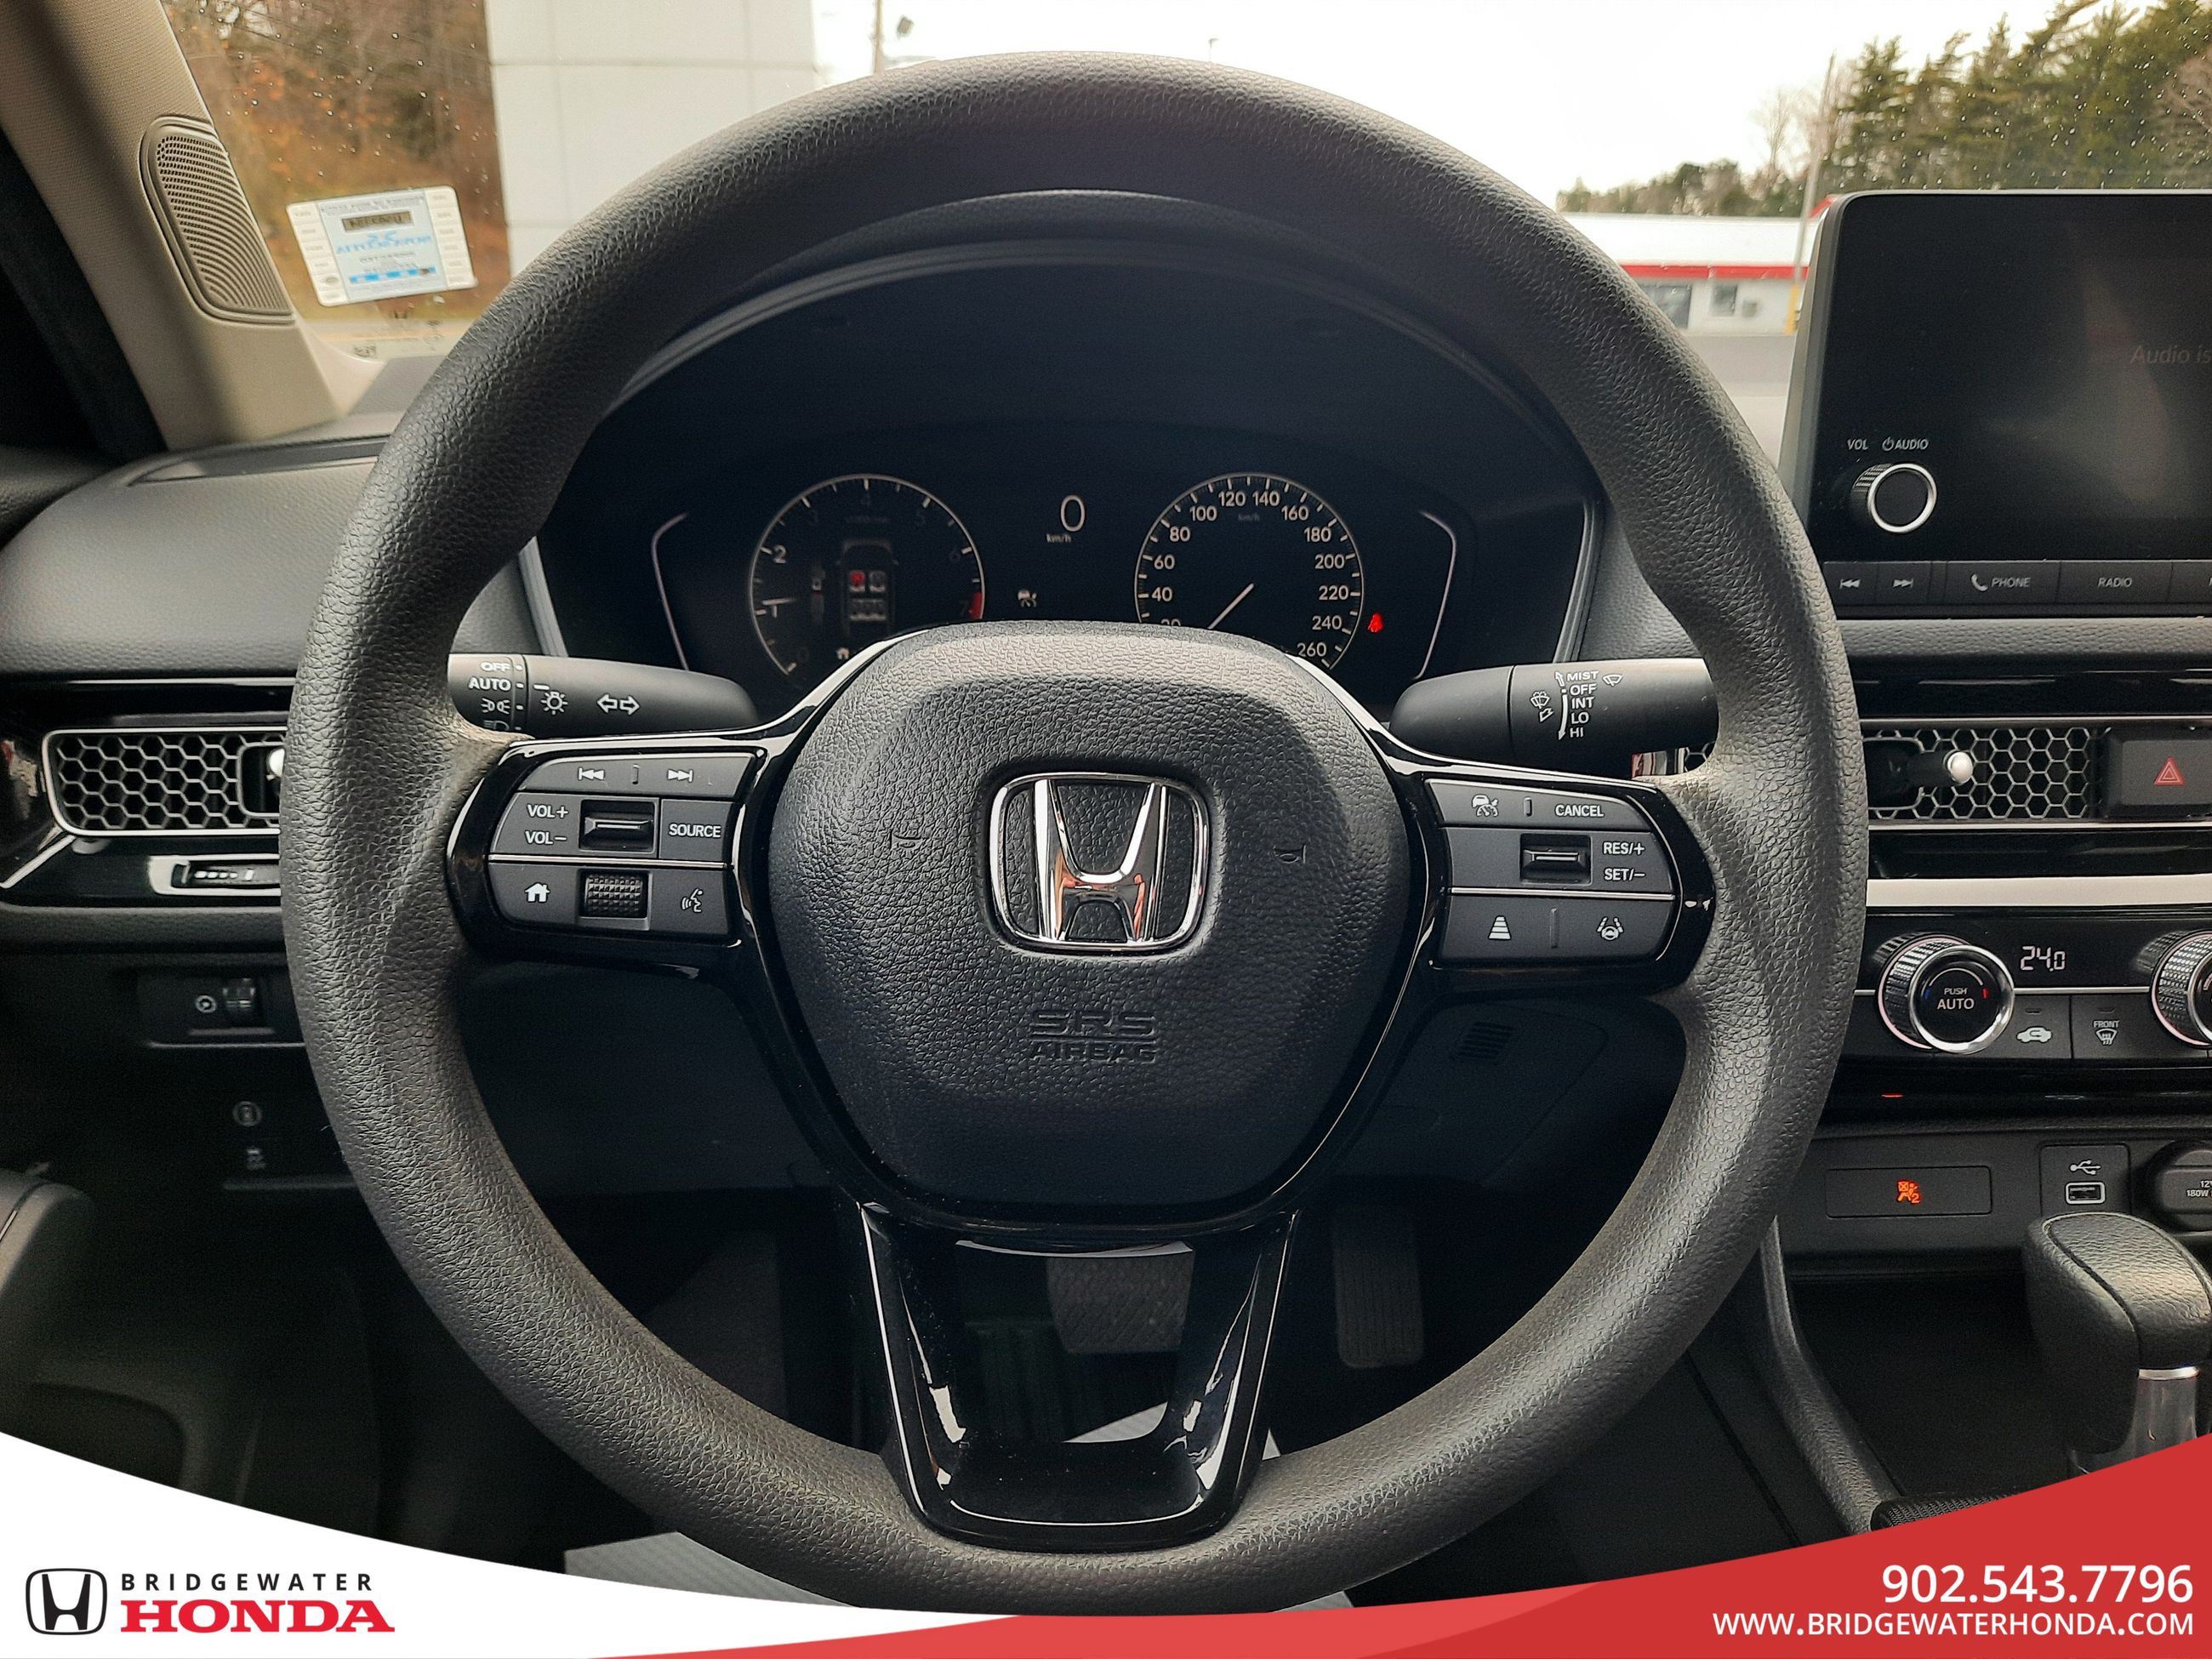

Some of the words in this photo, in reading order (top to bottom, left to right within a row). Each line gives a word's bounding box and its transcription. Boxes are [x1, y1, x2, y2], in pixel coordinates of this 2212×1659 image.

[2129, 345, 2190, 364] Audio
[1847, 438, 1869, 450] VOL
[1895, 438, 1929, 450] AUDIO
[1218, 491, 1246, 507] 120
[1252, 491, 1280, 507] 140
[1060, 494, 1086, 532] 0
[1190, 505, 1217, 522] 100
[1238, 513, 1260, 523] km/h
[1281, 505, 1308, 522] 160
[1046, 533, 1072, 544] km/h
[1169, 527, 1190, 543] 80
[1303, 527, 1332, 543] 180
[774, 544, 786, 563] 2
[1154, 555, 1176, 570] 60
[1314, 554, 1345, 569] 200
[1991, 577, 2031, 589] PHONE
[2097, 577, 2132, 589] RADIO
[1151, 587, 1172, 602] 40
[1319, 585, 1349, 601] 220
[1312, 615, 1342, 630] 240
[1297, 642, 1327, 658] 260
[480, 662, 510, 672] OFF
[1566, 670, 1599, 681] MIST
[468, 677, 511, 691] AUTO
[1570, 683, 1597, 696] OFF
[1571, 697, 1595, 710] INT
[1571, 711, 1589, 725] LO
[1570, 727, 1584, 738] HI
[1555, 804, 1605, 818] CANCEL
[668, 823, 722, 839] SOURCE
[1603, 841, 1645, 856] RES/+
[2020, 945, 2066, 972] 24.0
[1936, 998, 1975, 1011] AUTO
[1032, 1010, 1156, 1037] SRS
[2093, 1020, 2119, 1029] FRONT
[1029, 1043, 1158, 1064] AIRBAG
[2186, 1189, 2209, 1198] 180W
